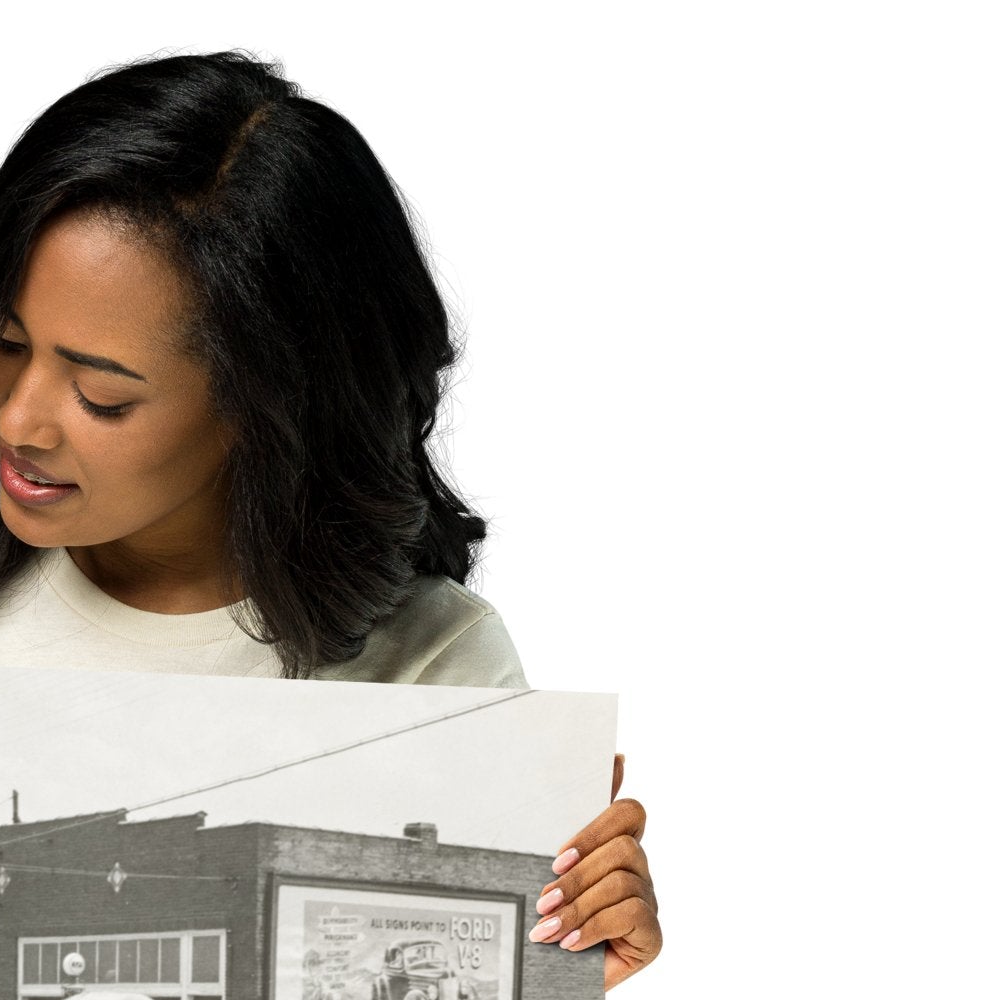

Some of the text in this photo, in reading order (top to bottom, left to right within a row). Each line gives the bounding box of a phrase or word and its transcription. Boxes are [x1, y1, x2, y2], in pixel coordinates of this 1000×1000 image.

[370, 918, 383, 929] ALL
[386, 919, 409, 930] SIGNS
[411, 920, 434, 931] POINT
[436, 922, 446, 932] TO
[449, 916, 494, 941] FORD
